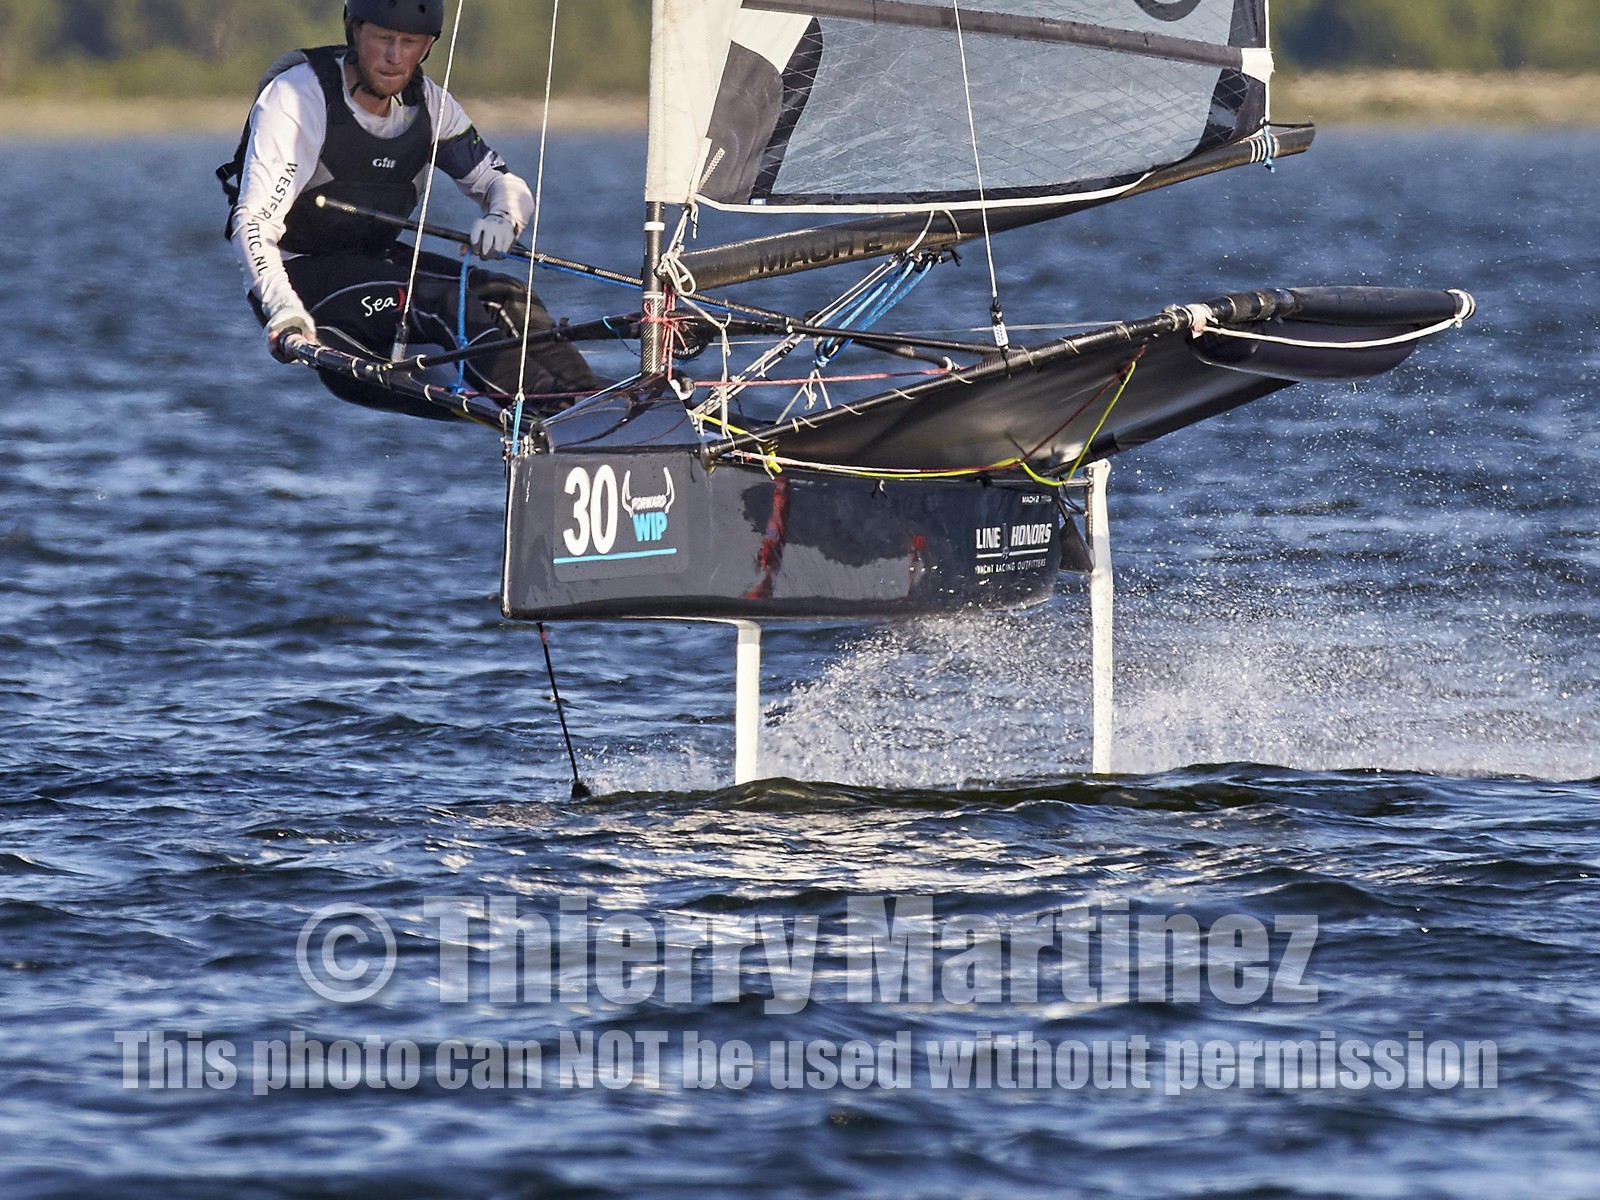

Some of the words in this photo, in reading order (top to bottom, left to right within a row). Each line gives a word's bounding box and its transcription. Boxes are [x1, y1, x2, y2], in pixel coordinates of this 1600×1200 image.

[361, 295, 398, 317] Sea
[562, 464, 619, 556] 30
[632, 511, 668, 542] WIP
[975, 527, 1001, 549] LINE
[1010, 523, 1052, 546] HONORS
